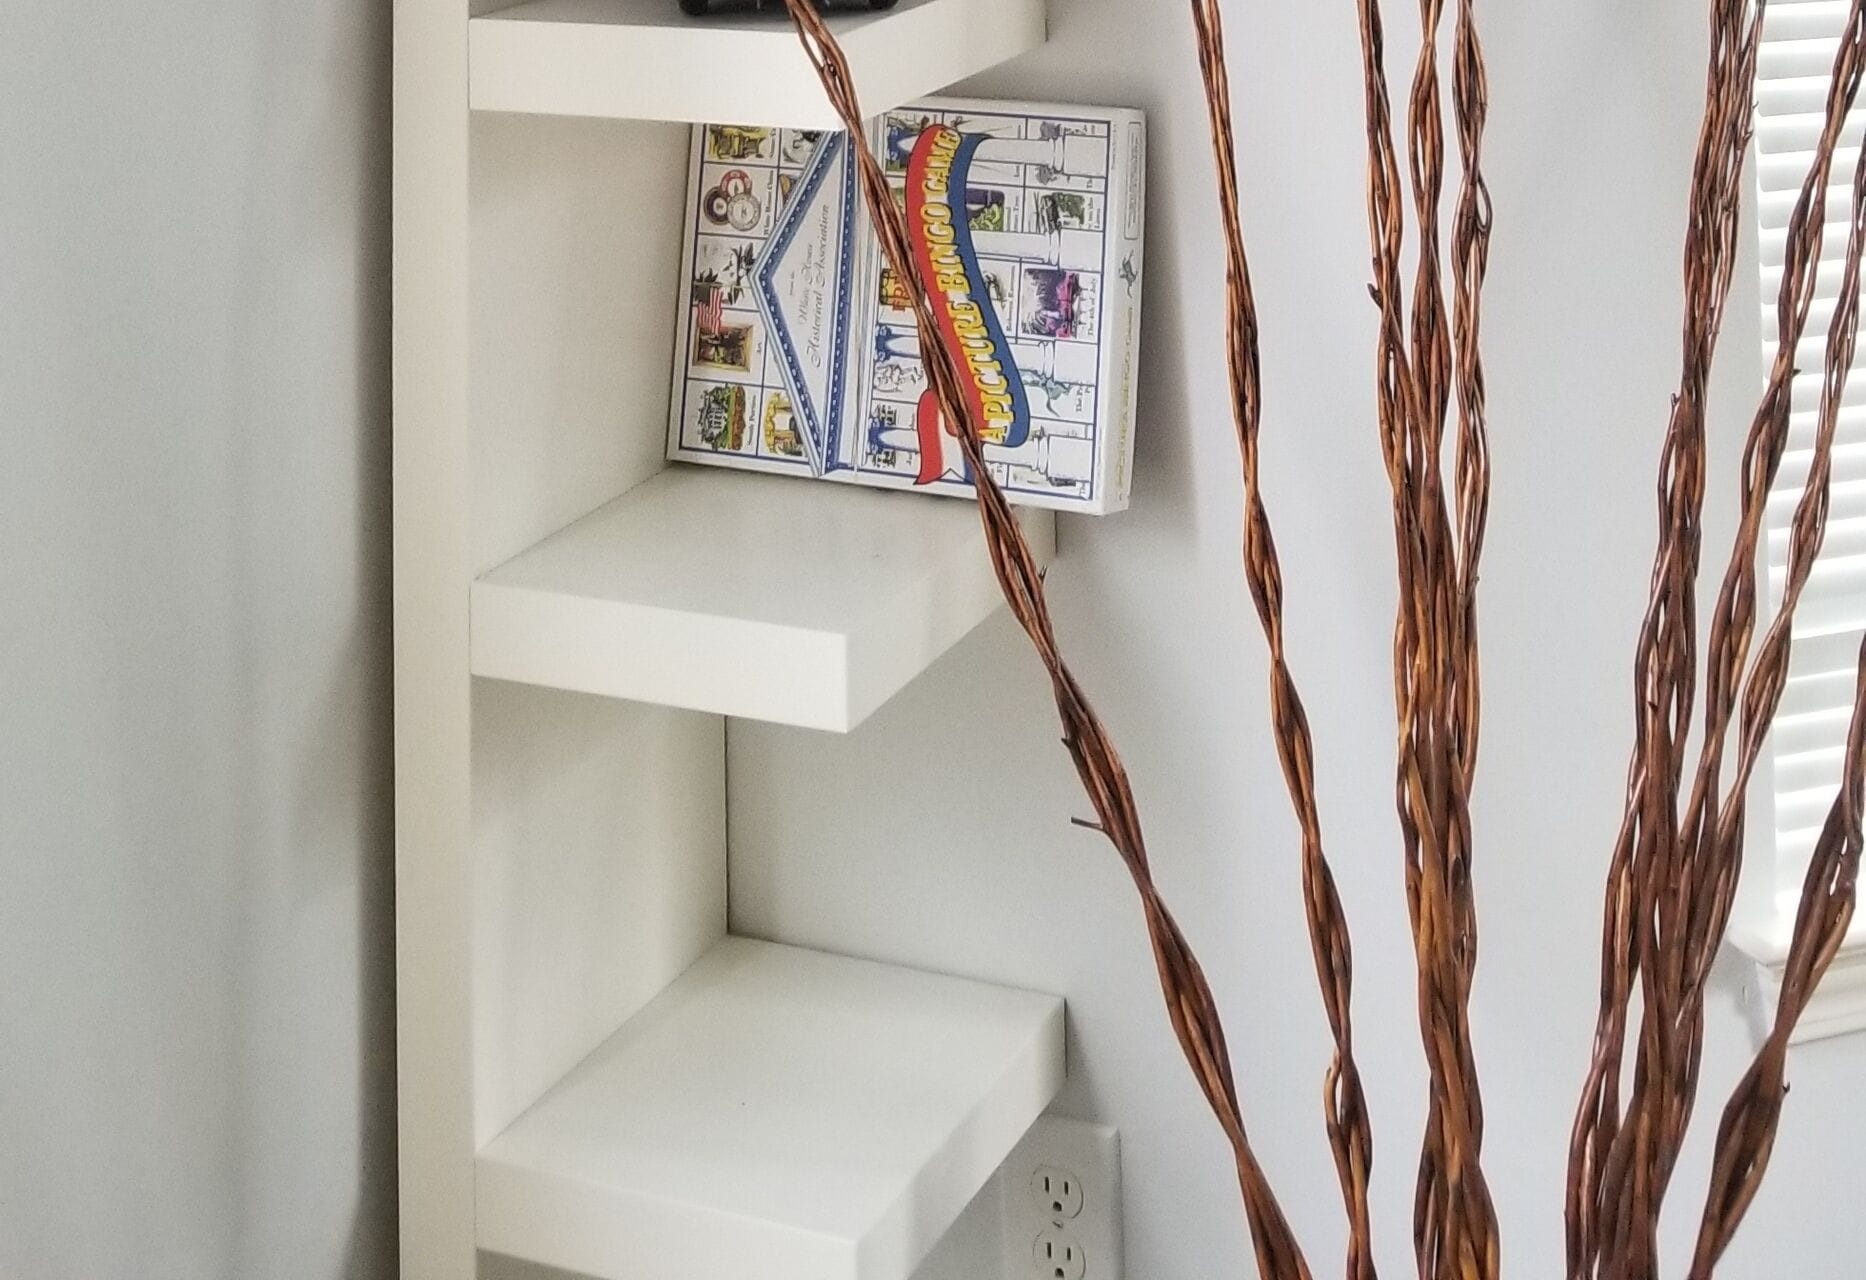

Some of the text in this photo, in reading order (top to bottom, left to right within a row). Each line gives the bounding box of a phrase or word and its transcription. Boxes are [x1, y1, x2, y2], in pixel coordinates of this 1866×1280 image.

[806, 204, 830, 368] Historical Association
[920, 129, 1014, 444] A PICTURE BINGO GAME
